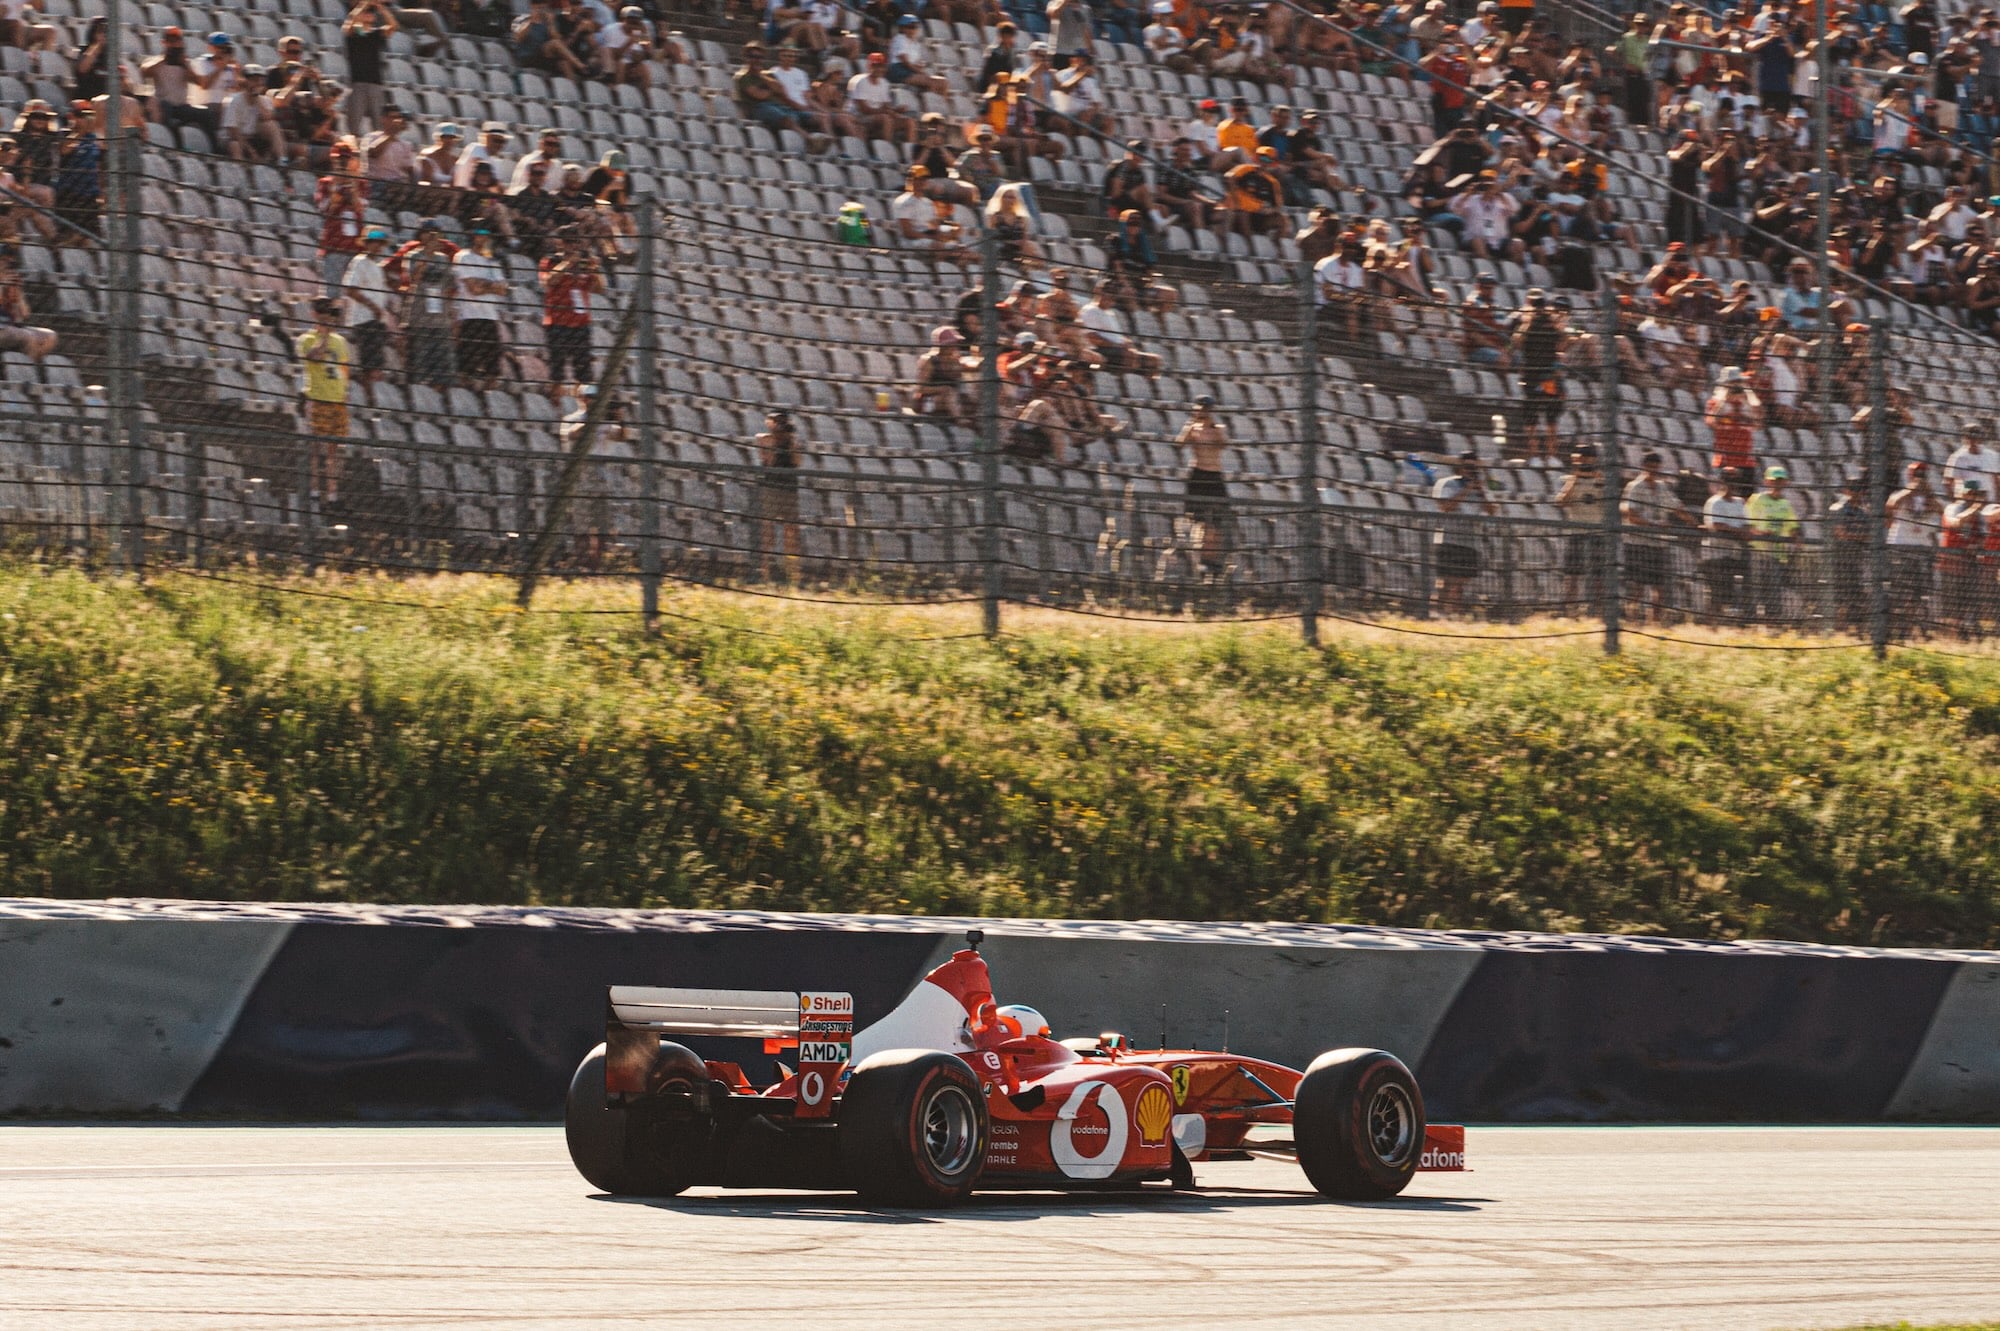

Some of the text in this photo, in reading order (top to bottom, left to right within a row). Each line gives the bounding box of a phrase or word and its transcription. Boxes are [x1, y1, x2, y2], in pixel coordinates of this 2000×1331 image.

[813, 997, 850, 1010] Shell
[801, 1043, 837, 1060] AMD
[1072, 1125, 1108, 1135] vodafone
[990, 1142, 1019, 1151] rembo
[1418, 1147, 1464, 1168] afone
